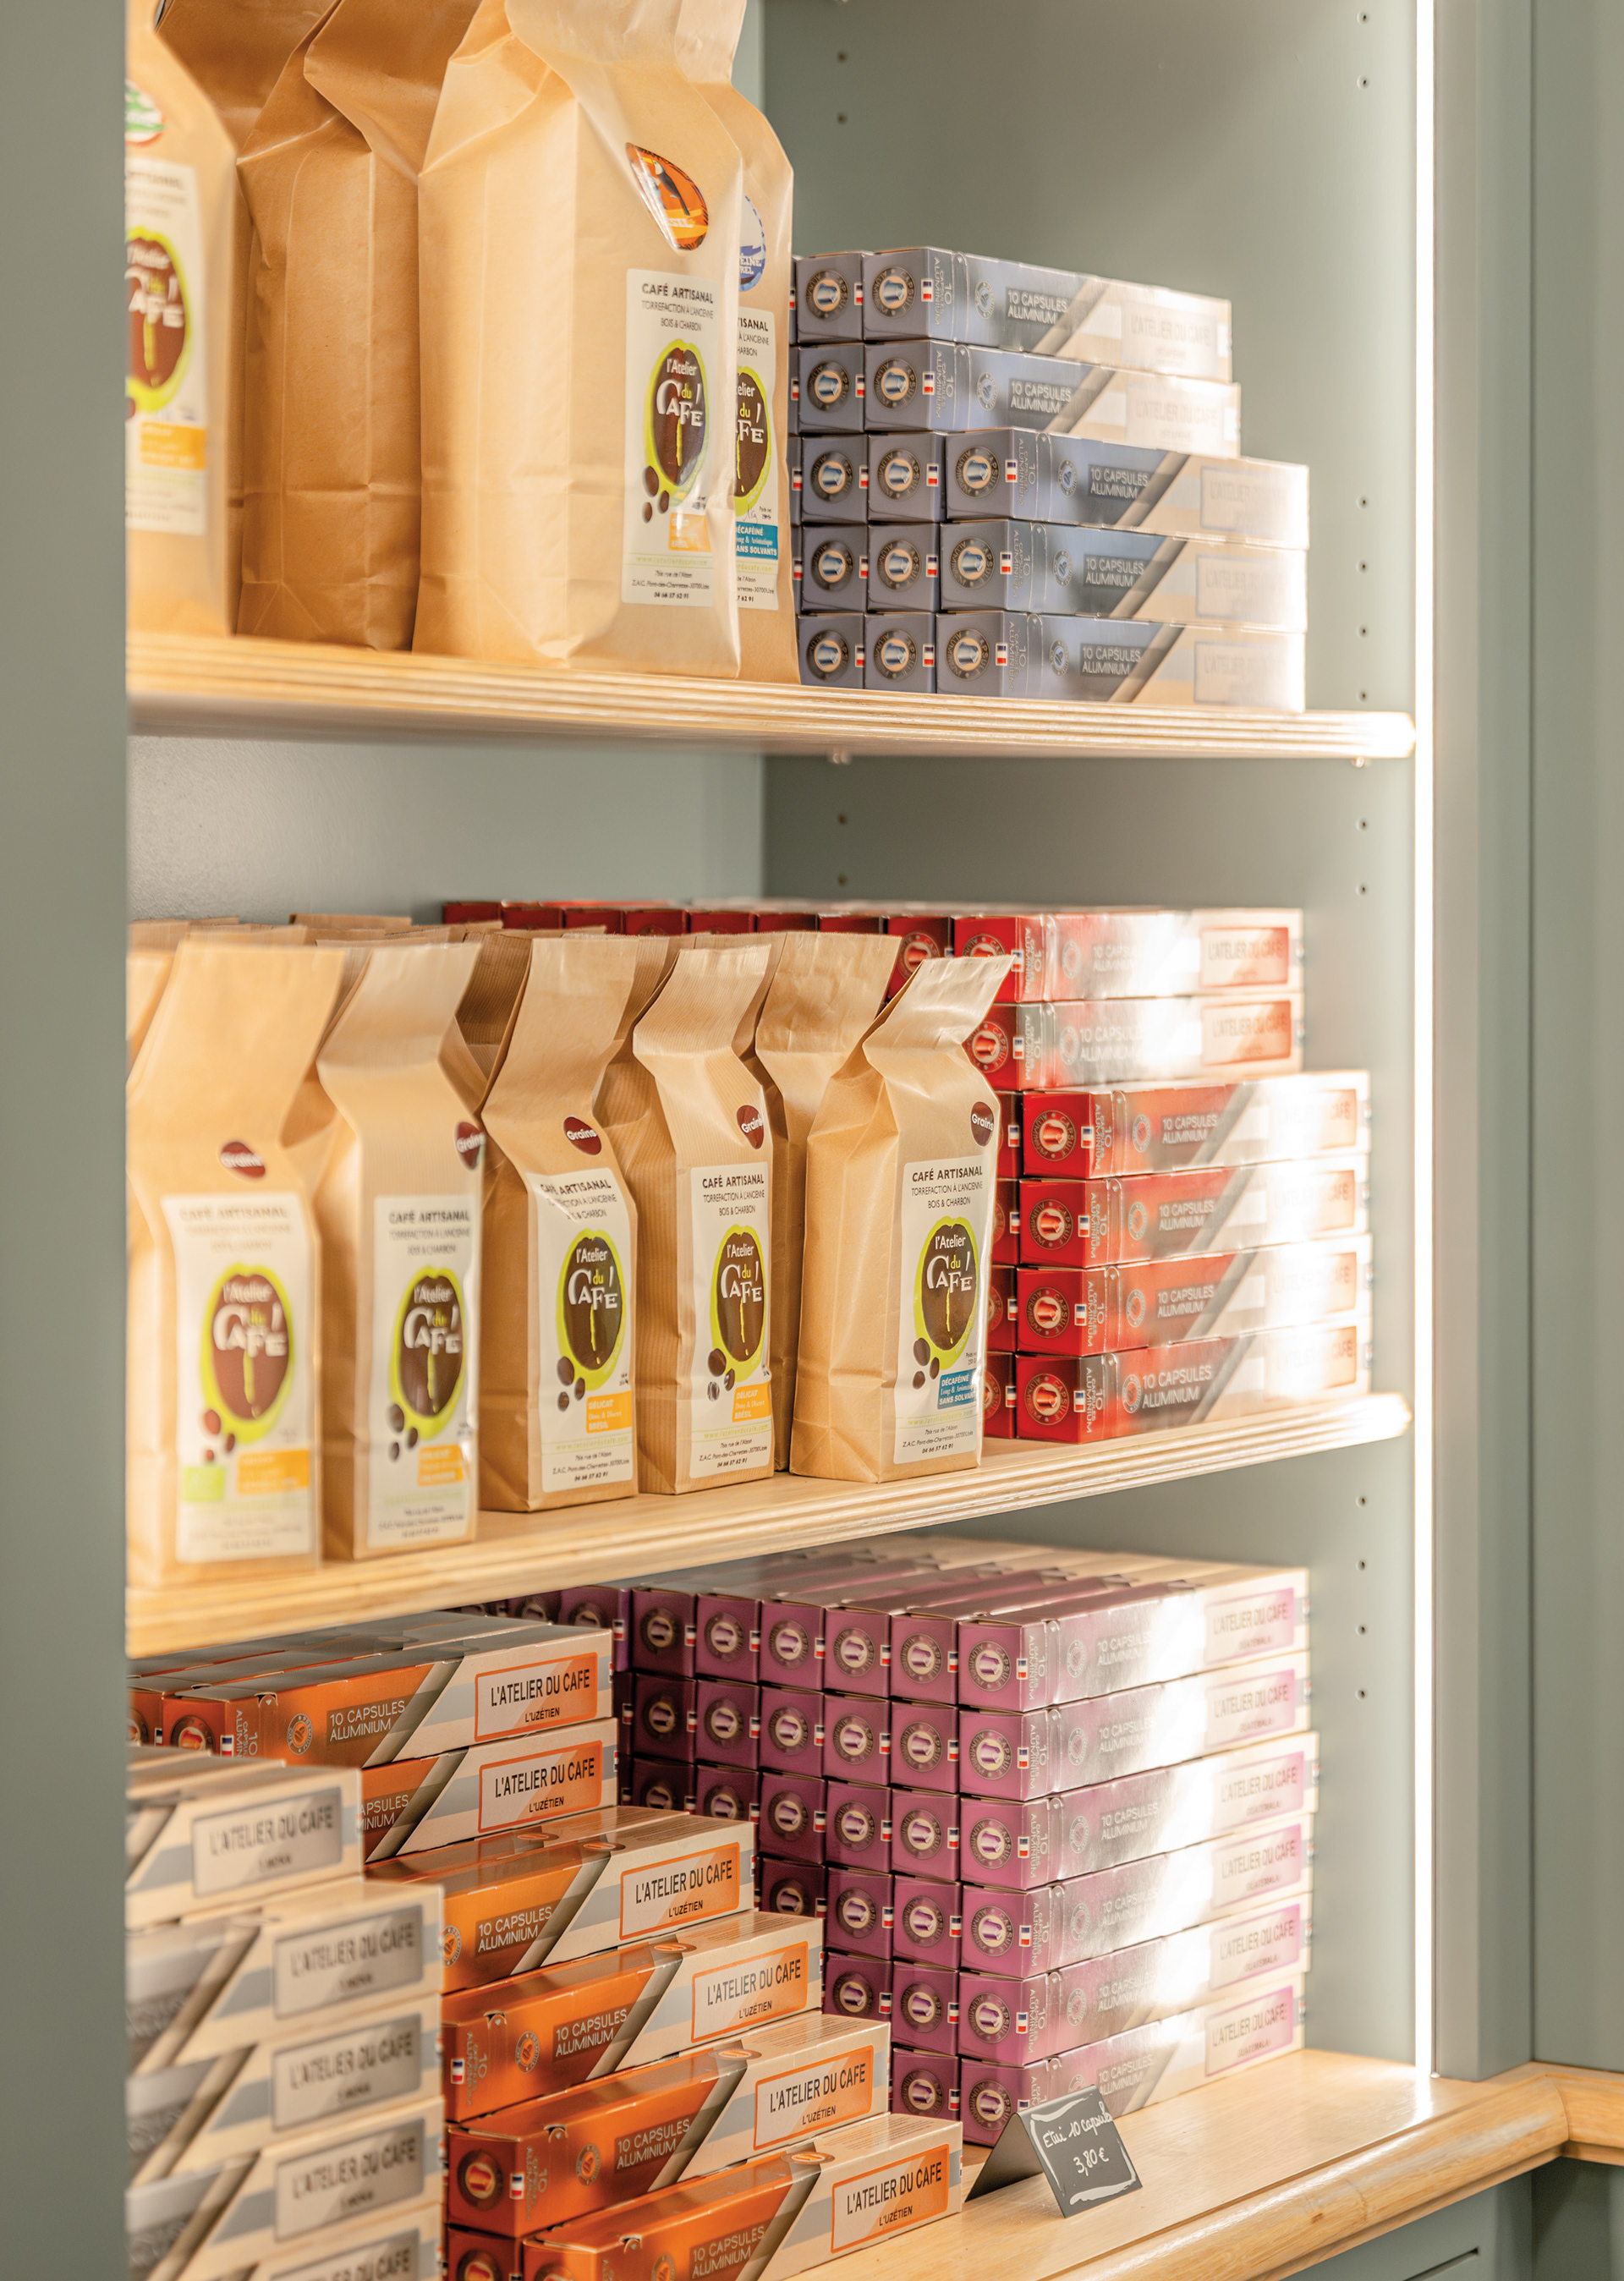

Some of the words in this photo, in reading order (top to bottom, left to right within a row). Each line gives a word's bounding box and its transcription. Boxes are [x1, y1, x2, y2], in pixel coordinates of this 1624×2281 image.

[642, 283, 668, 296] CAFÉ
[672, 287, 713, 304] ARTISANAL
[1008, 291, 1018, 304] 10
[1020, 292, 1067, 312] CAPSULES
[1008, 305, 1056, 324] ALUMINIUM
[679, 321, 701, 332] CHARBON
[1012, 381, 1021, 396] 10
[1023, 383, 1071, 402] CAPSULES
[1012, 397, 1060, 413] ALUMINIUM
[1090, 467, 1100, 480] 10
[1103, 469, 1148, 486] CAPSULES
[1090, 483, 1138, 499] ALUMINIUM
[749, 546, 776, 556] SOLVANTS
[1086, 557, 1095, 571] 10
[1099, 559, 1144, 575] CAPSULES
[1086, 572, 1133, 586] ALUMINIUM
[1083, 647, 1092, 661] 10
[1095, 649, 1140, 664] CAPSULES
[1083, 661, 1132, 676] ALUMINIUM
[741, 1115, 763, 1133] Grains
[972, 1113, 994, 1132] Grains
[1162, 1118, 1172, 1131] 10
[1175, 1115, 1217, 1130] CAPSULES
[567, 1127, 597, 1142] Grains
[1162, 1129, 1207, 1144] ALUMINIUM
[702, 1175, 723, 1189] CAFÉ
[726, 1174, 764, 1187] ARTISANAL
[912, 1169, 934, 1182] CAFÉ
[937, 1166, 983, 1181] ARTISANAL
[559, 1180, 611, 1195] ARTISANAL
[911, 1185, 952, 1197] TORREFACTION
[703, 1191, 739, 1204] TORREFACTION
[928, 1200, 941, 1209] BOIS
[946, 1197, 971, 1207] CHARBON
[719, 1208, 729, 1217] BOIS
[734, 1204, 755, 1215] CHARBON
[1160, 1205, 1169, 1218] 10
[1172, 1201, 1214, 1216] CAPSULES
[1160, 1215, 1204, 1231] ALUMINIUM
[727, 1242, 754, 1258] l'Atelier
[935, 1235, 966, 1250] l'Atelier
[950, 1254, 961, 1269] du
[593, 1269, 604, 1285] du
[741, 1264, 751, 1279] du
[1158, 1291, 1167, 1305] 10
[1170, 1286, 1214, 1304] CAPSULES
[1157, 1302, 1204, 1319] ALUMINIUM
[941, 1374, 969, 1387] DÉCAFÉINÉ
[1143, 1373, 1155, 1390] 10
[1159, 1365, 1212, 1388] CAPSULES
[939, 1396, 953, 1405] SANS
[1142, 1385, 1199, 1409] ALUMINIUM
[491, 1678, 542, 1707] L'ATELIER
[546, 1675, 560, 1696] DU
[563, 1669, 590, 1694] CAFE
[330, 1713, 343, 1727] 10
[347, 1700, 405, 1722] CAPSULES
[524, 1707, 560, 1723] L'UZÉTIEN
[330, 1718, 392, 1741] ALUMINIUM
[496, 1767, 547, 1798] L'ATELIER
[551, 1764, 565, 1785] DU
[568, 1757, 595, 1781] CAFE
[360, 1795, 409, 1816] APSULES
[529, 1796, 564, 1813] L'UZÉTIEN
[1113, 1802, 1159, 1825] CAPSULES
[1100, 1820, 1149, 1841] ALUMINIUM
[636, 1873, 686, 1904] L'ATELIER
[689, 1869, 704, 1891] DU
[706, 1860, 732, 1885] CAFE
[668, 1900, 704, 1918] L'UZÉTIEN
[478, 1922, 491, 1936] 10
[495, 1906, 552, 1933] CAPSULES
[477, 1927, 539, 1953] ALUMINIUM
[707, 1974, 757, 2006] L'ATELIER
[760, 1970, 773, 1990] DU
[776, 1959, 801, 1986] CAFE
[738, 2000, 772, 2019] L'UZÉTIEN
[556, 2027, 568, 2041] 10
[572, 2009, 628, 2036] CAPSULES
[556, 2029, 614, 2057] ALUMINIUM
[1099, 2070, 1109, 2081] 10
[1111, 2053, 1153, 2080] CAPSULES
[771, 2079, 820, 2113] L'ATELIER
[823, 2075, 837, 2096] DU
[840, 2064, 865, 2090] CAFE
[802, 2105, 836, 2125] L'UZÉTIEN
[617, 2140, 630, 2153] 10
[634, 2119, 690, 2148] CAPSULES
[1042, 2126, 1067, 2148] Etui
[1069, 2120, 1081, 2138] 10
[617, 2138, 677, 2169] ALUMINIUM
[1073, 2150, 1098, 2176] 3,80
[1099, 2147, 1110, 2163] €
[847, 2180, 897, 2215] L'ATELIER
[899, 2175, 914, 2196] DU
[916, 2162, 941, 2190] CAFE
[880, 2206, 913, 2226] L'UZÉTIEN
[692, 2247, 705, 2262] 10
[709, 2226, 765, 2259] CAPSULES
[691, 2245, 752, 2278] ALUMINIUM
